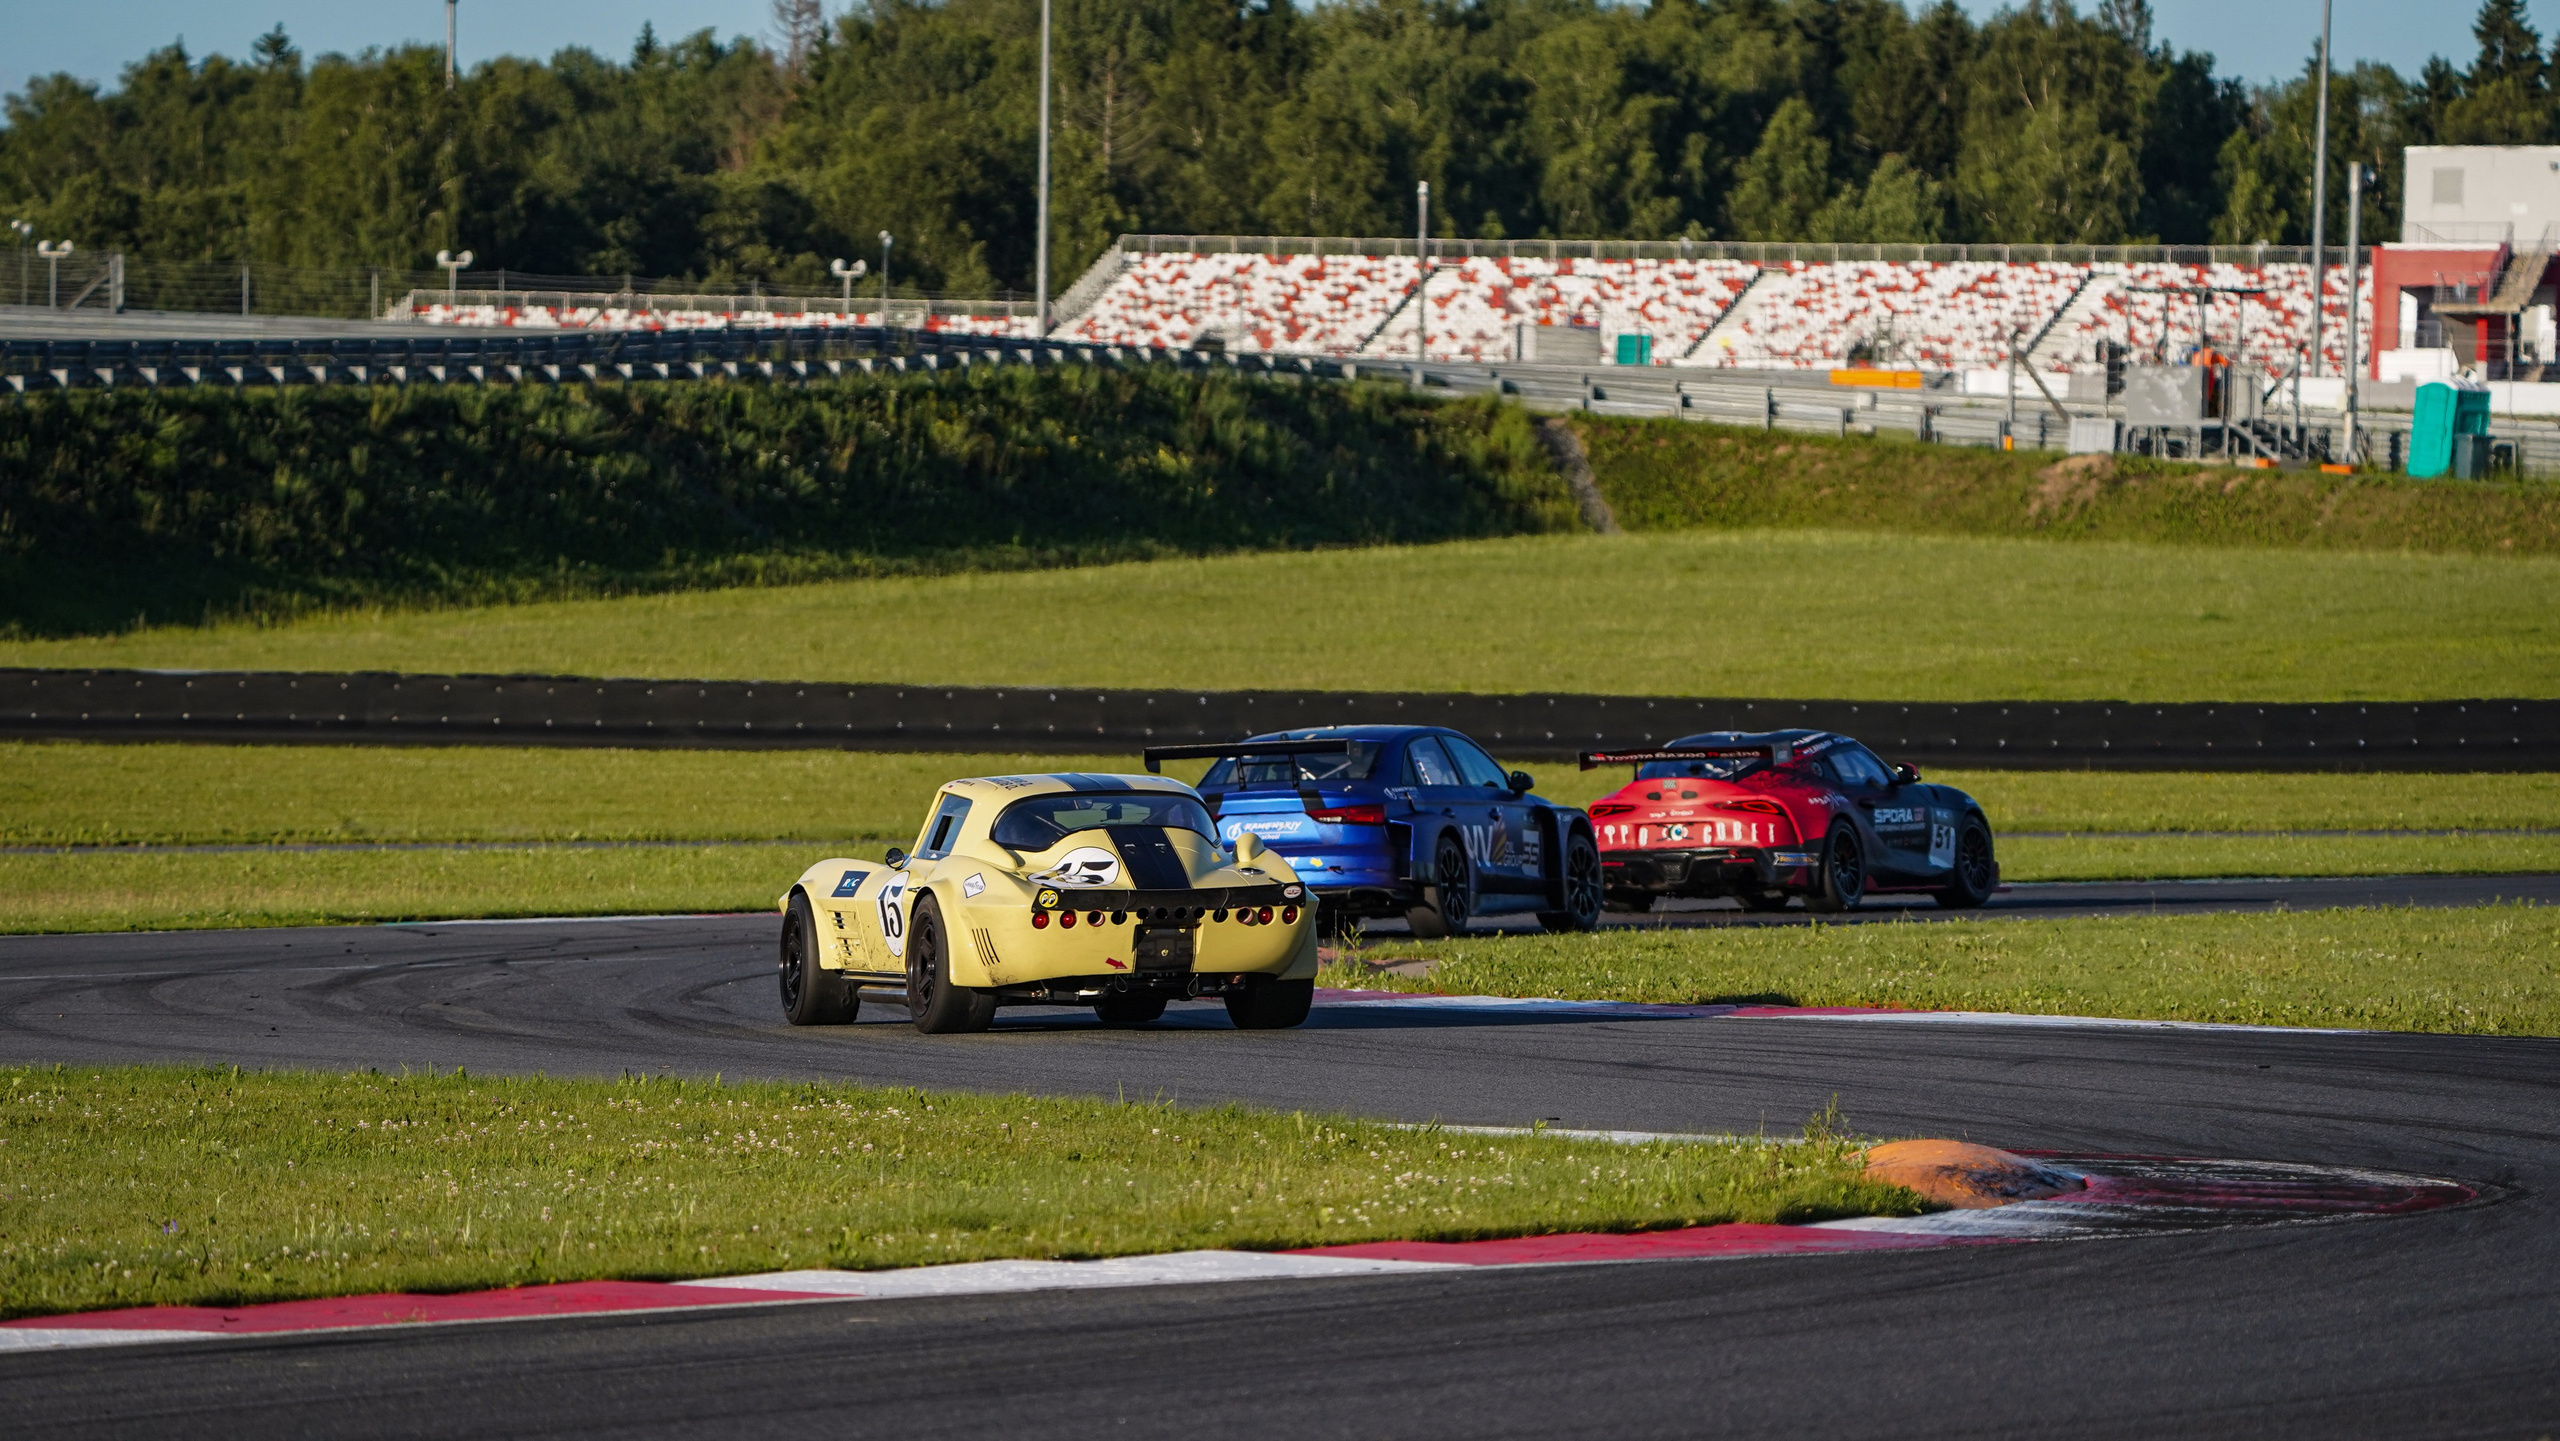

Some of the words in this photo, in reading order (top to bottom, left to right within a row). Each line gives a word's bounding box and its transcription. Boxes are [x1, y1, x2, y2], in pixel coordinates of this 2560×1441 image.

[1874, 808, 1914, 823] SPORA
[1935, 825, 1951, 850] 51
[1524, 842, 1539, 865] 55
[878, 885, 905, 938] 15
